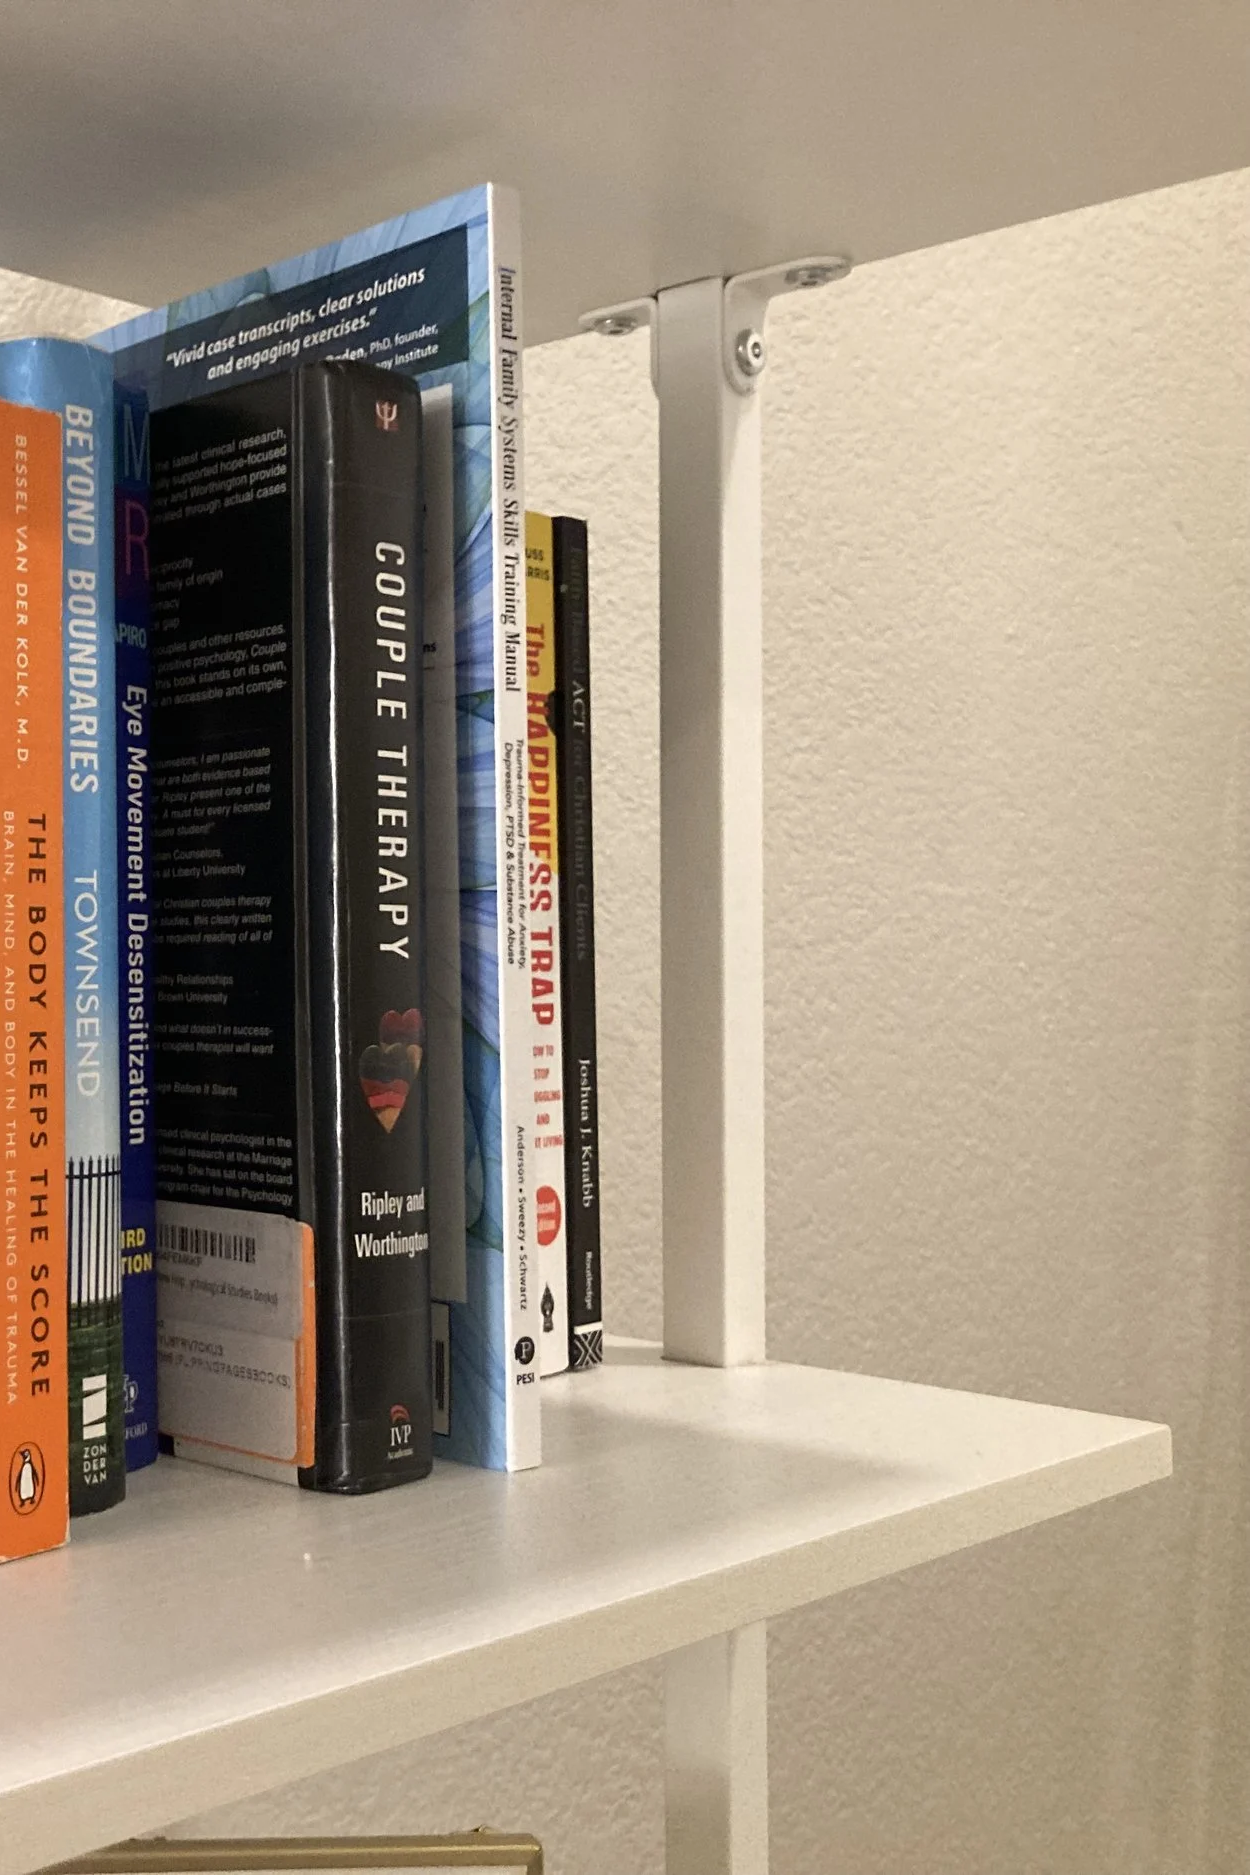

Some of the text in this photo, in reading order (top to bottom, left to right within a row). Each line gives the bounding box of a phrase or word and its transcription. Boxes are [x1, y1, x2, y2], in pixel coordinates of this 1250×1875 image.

[166, 266, 426, 367] "Vivid case transcripts, clear solutions
[207, 307, 378, 380] and engaging exercises."
[498, 267, 521, 691] Internal Family Systems Skills Training Manual
[15, 435, 29, 769] BESSEL VAN DER KOLK, M.D.
[65, 404, 98, 794] BEYOND BOUNDARIES
[375, 542, 409, 959] COUPLE THERAPY
[572, 681, 586, 734] ACT
[504, 742, 514, 810] Depression,
[516, 739, 524, 837] Trauma-Informed
[526, 624, 554, 1026] The HAPPINESS TRAP
[506, 815, 514, 847] PTSD
[517, 842, 526, 899] Treatment
[122, 685, 149, 1144] Eye Movement Desensitization
[517, 904, 526, 919] for
[73, 869, 99, 1096] TOWNSEND
[2, 811, 18, 1405] BRAIN, MIND, AND BODY IN THE HEALING OF TRAUMA
[28, 814, 49, 1397] THE BODY KEEPS THE SCORE
[578, 1059, 593, 1208] Joshua J. Knabb
[354, 1231, 428, 1258] Worthington
[361, 1187, 425, 1220] Ripley and
[517, 1126, 528, 1311] Anderson Sweezy Schwartz
[585, 1251, 593, 1310] Routledge
[516, 1372, 535, 1385] PESI
[390, 1424, 411, 1446] IVP
